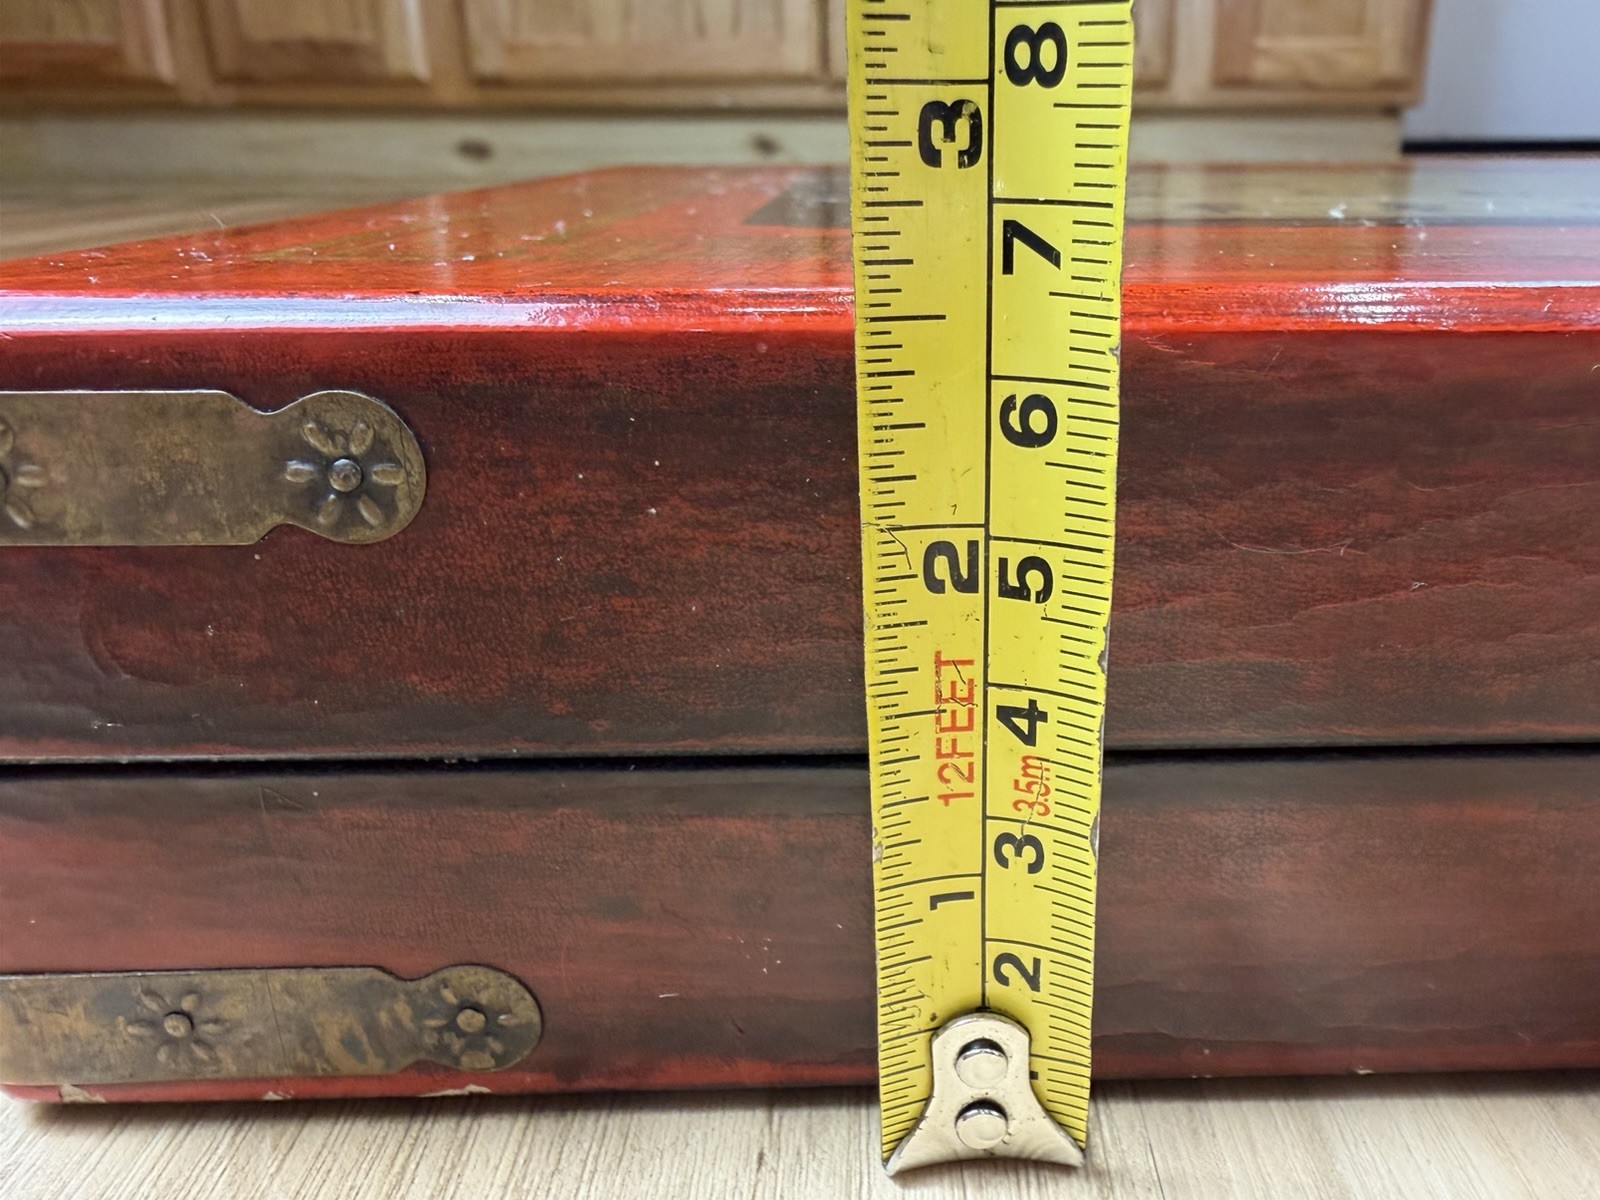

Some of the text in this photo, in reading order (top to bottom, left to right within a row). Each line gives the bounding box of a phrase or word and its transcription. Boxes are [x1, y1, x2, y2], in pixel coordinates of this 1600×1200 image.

[1004, 21, 1068, 89] 8
[918, 98, 983, 170] 3
[1002, 219, 1062, 276] 7
[1000, 393, 1058, 449] 6
[923, 539, 980, 595] 2
[998, 555, 1054, 605] 5
[996, 698, 1049, 747] 4
[993, 832, 1045, 875] 3
[930, 891, 975, 911] 1
[993, 951, 1042, 993] 2
